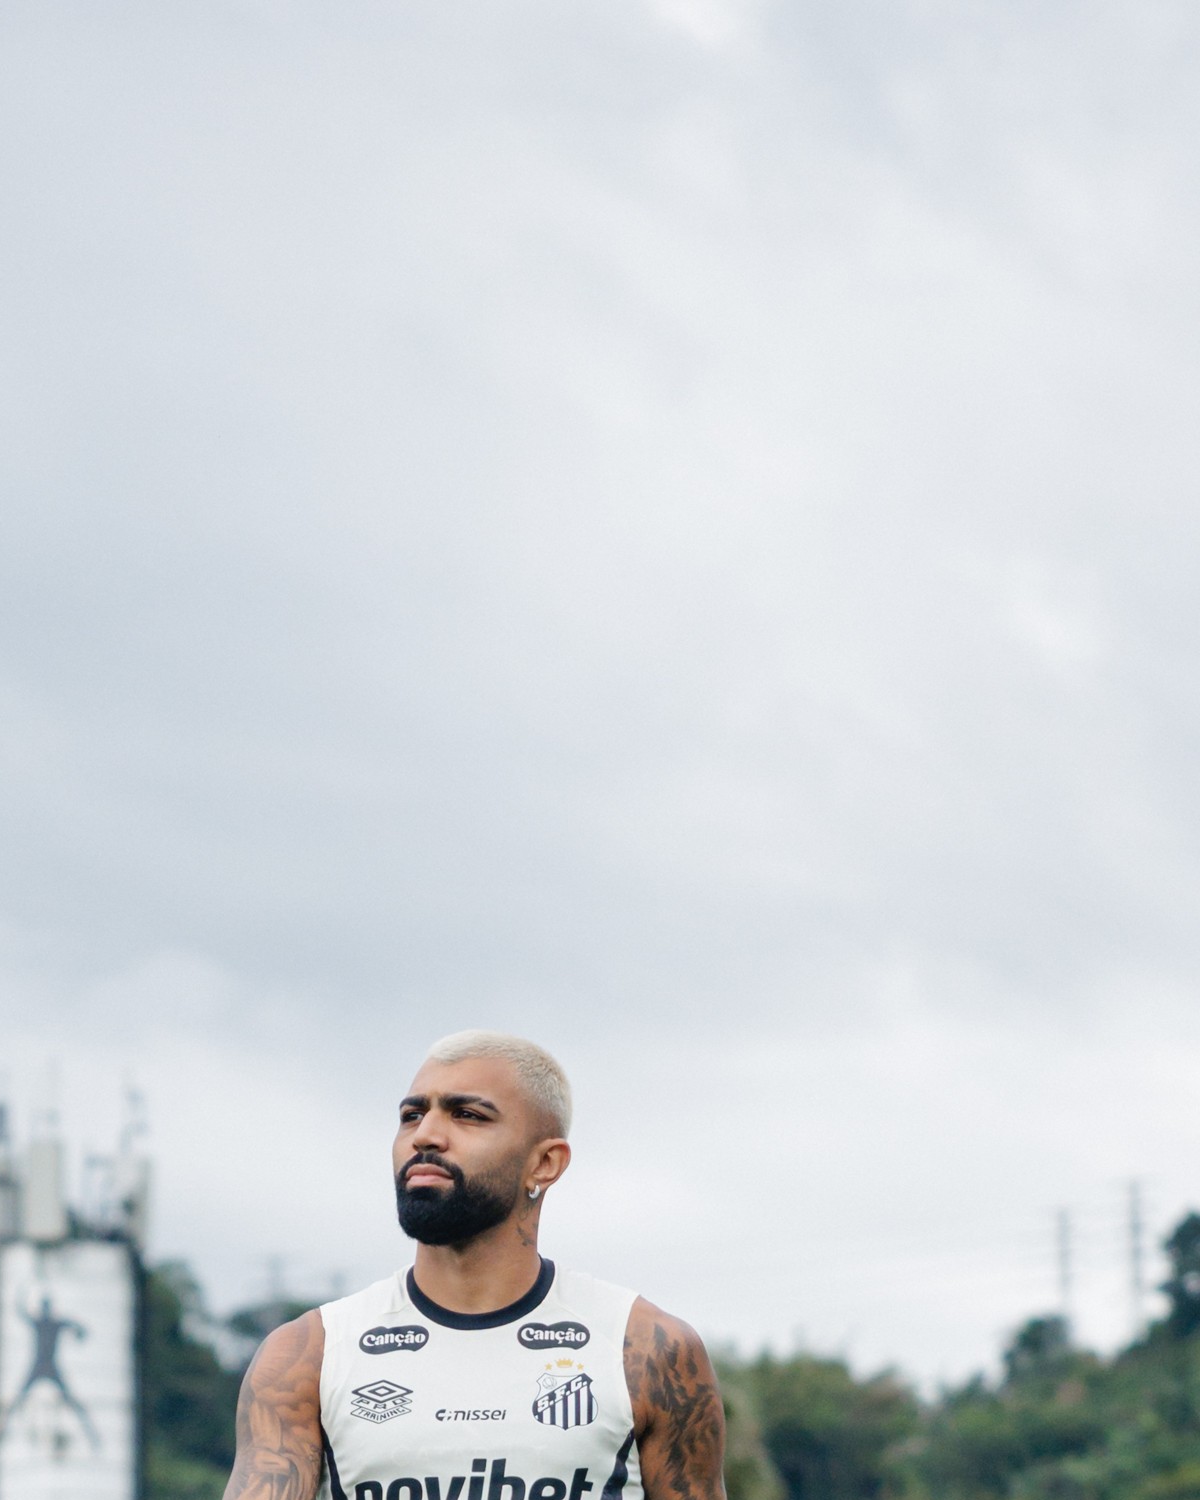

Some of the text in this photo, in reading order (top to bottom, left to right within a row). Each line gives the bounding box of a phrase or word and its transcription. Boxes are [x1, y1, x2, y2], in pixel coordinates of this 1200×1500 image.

[362, 1329, 426, 1347] Canção
[520, 1326, 587, 1345] Canção
[357, 1408, 407, 1422] TRAINING
